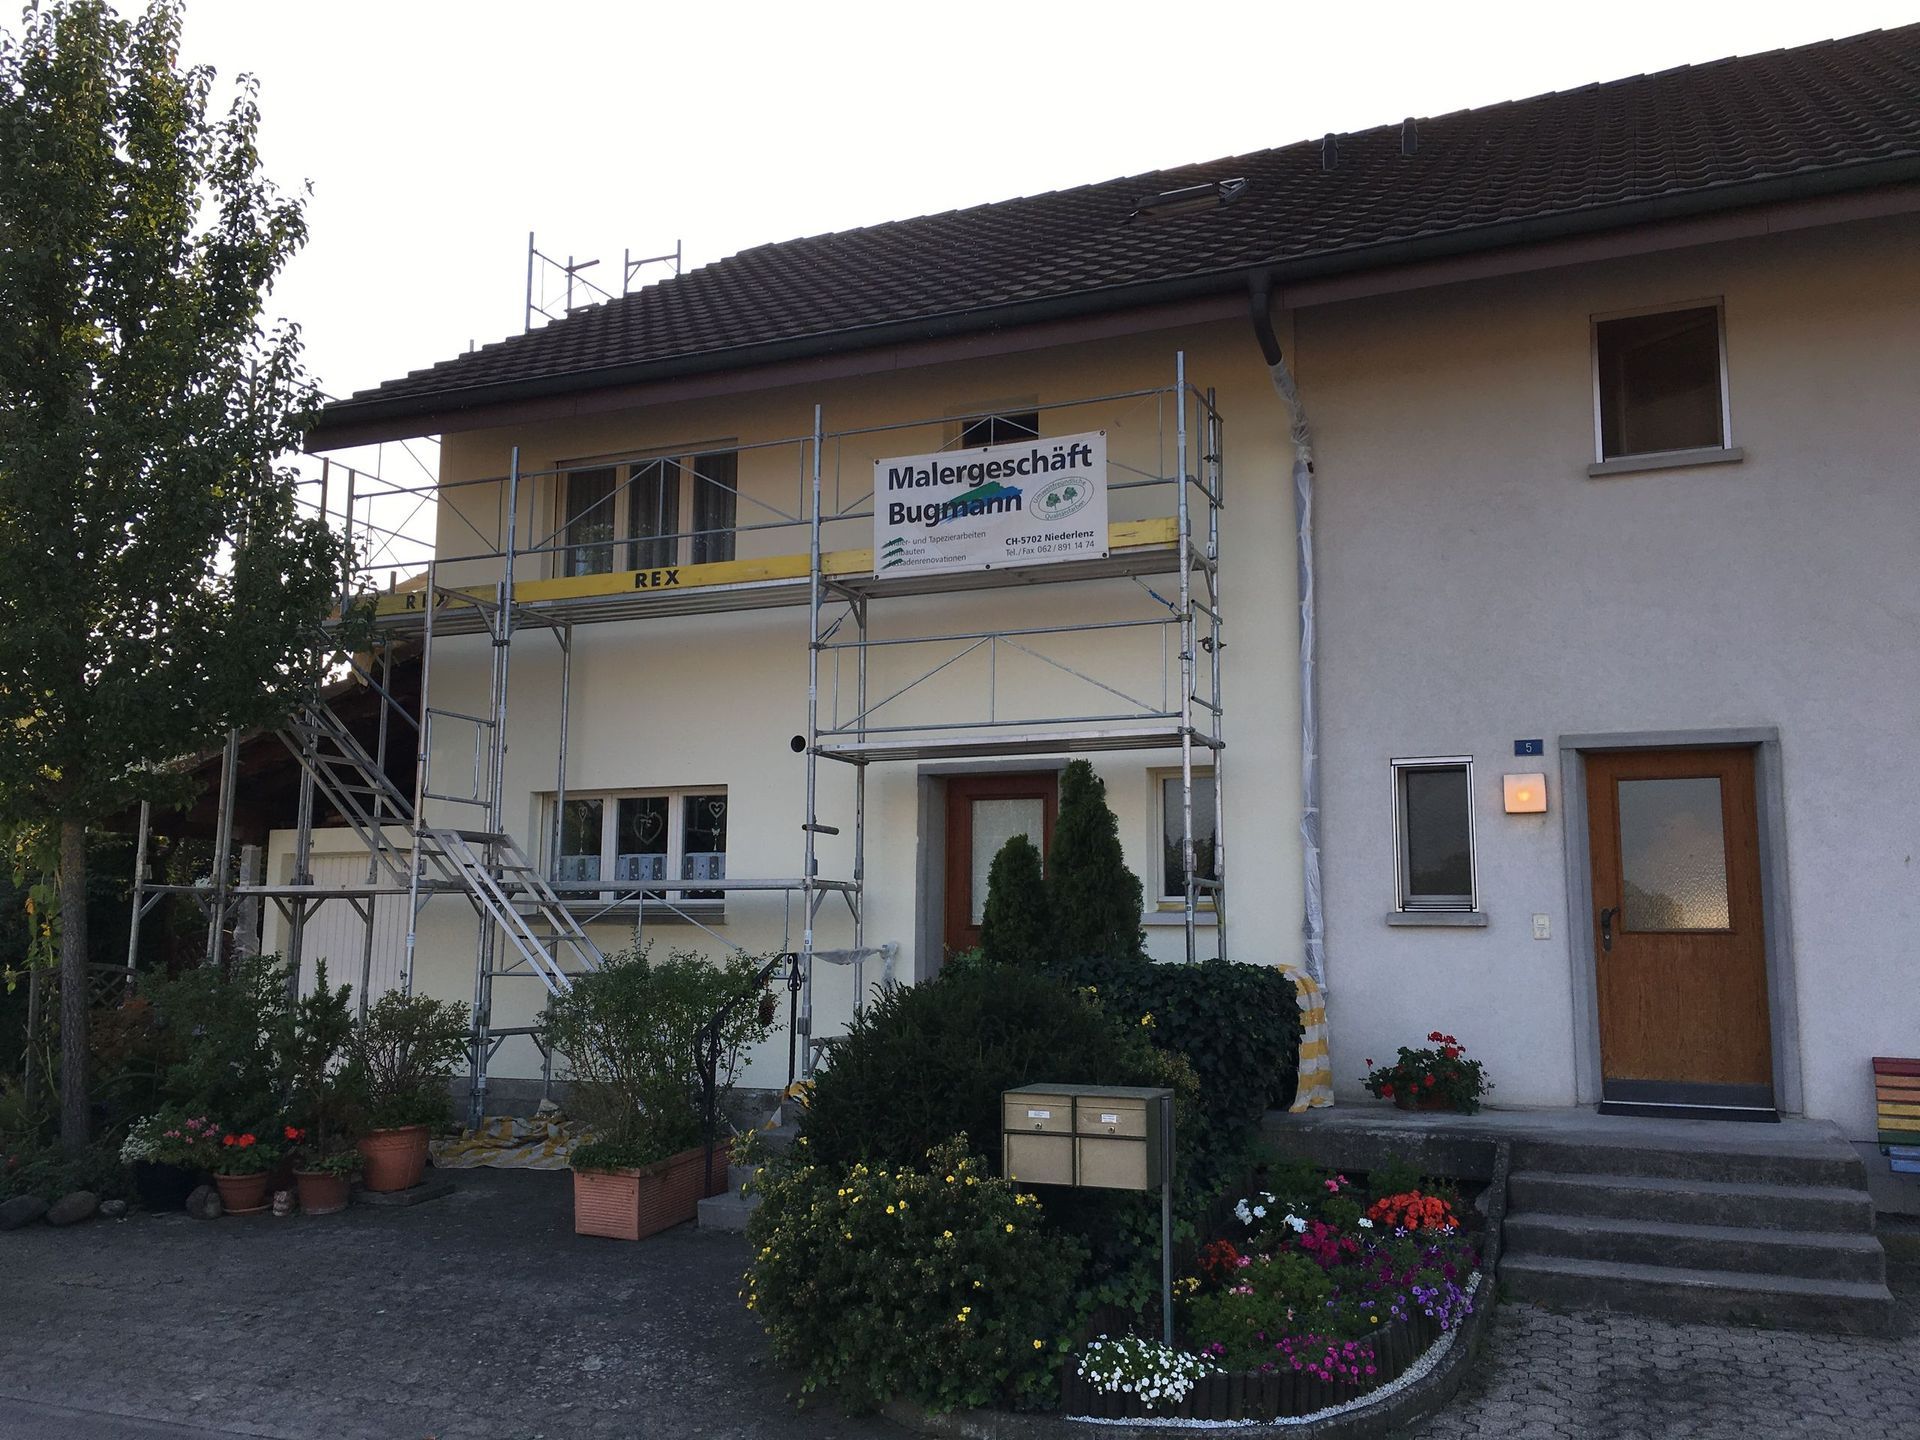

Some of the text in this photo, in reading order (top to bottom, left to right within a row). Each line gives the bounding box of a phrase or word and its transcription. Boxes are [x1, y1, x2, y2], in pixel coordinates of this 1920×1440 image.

[889, 443, 1092, 490] Malergeschäft
[889, 493, 1022, 527] Bugmann
[913, 537, 926, 545] und
[929, 531, 986, 544] Tapezierarbeiten
[1006, 530, 1094, 546] CH-5702 Niederlenz
[1006, 547, 1035, 556] Tel./Fax
[1086, 540, 1094, 548] 74
[635, 569, 680, 588] REX
[1525, 742, 1532, 753] 5
